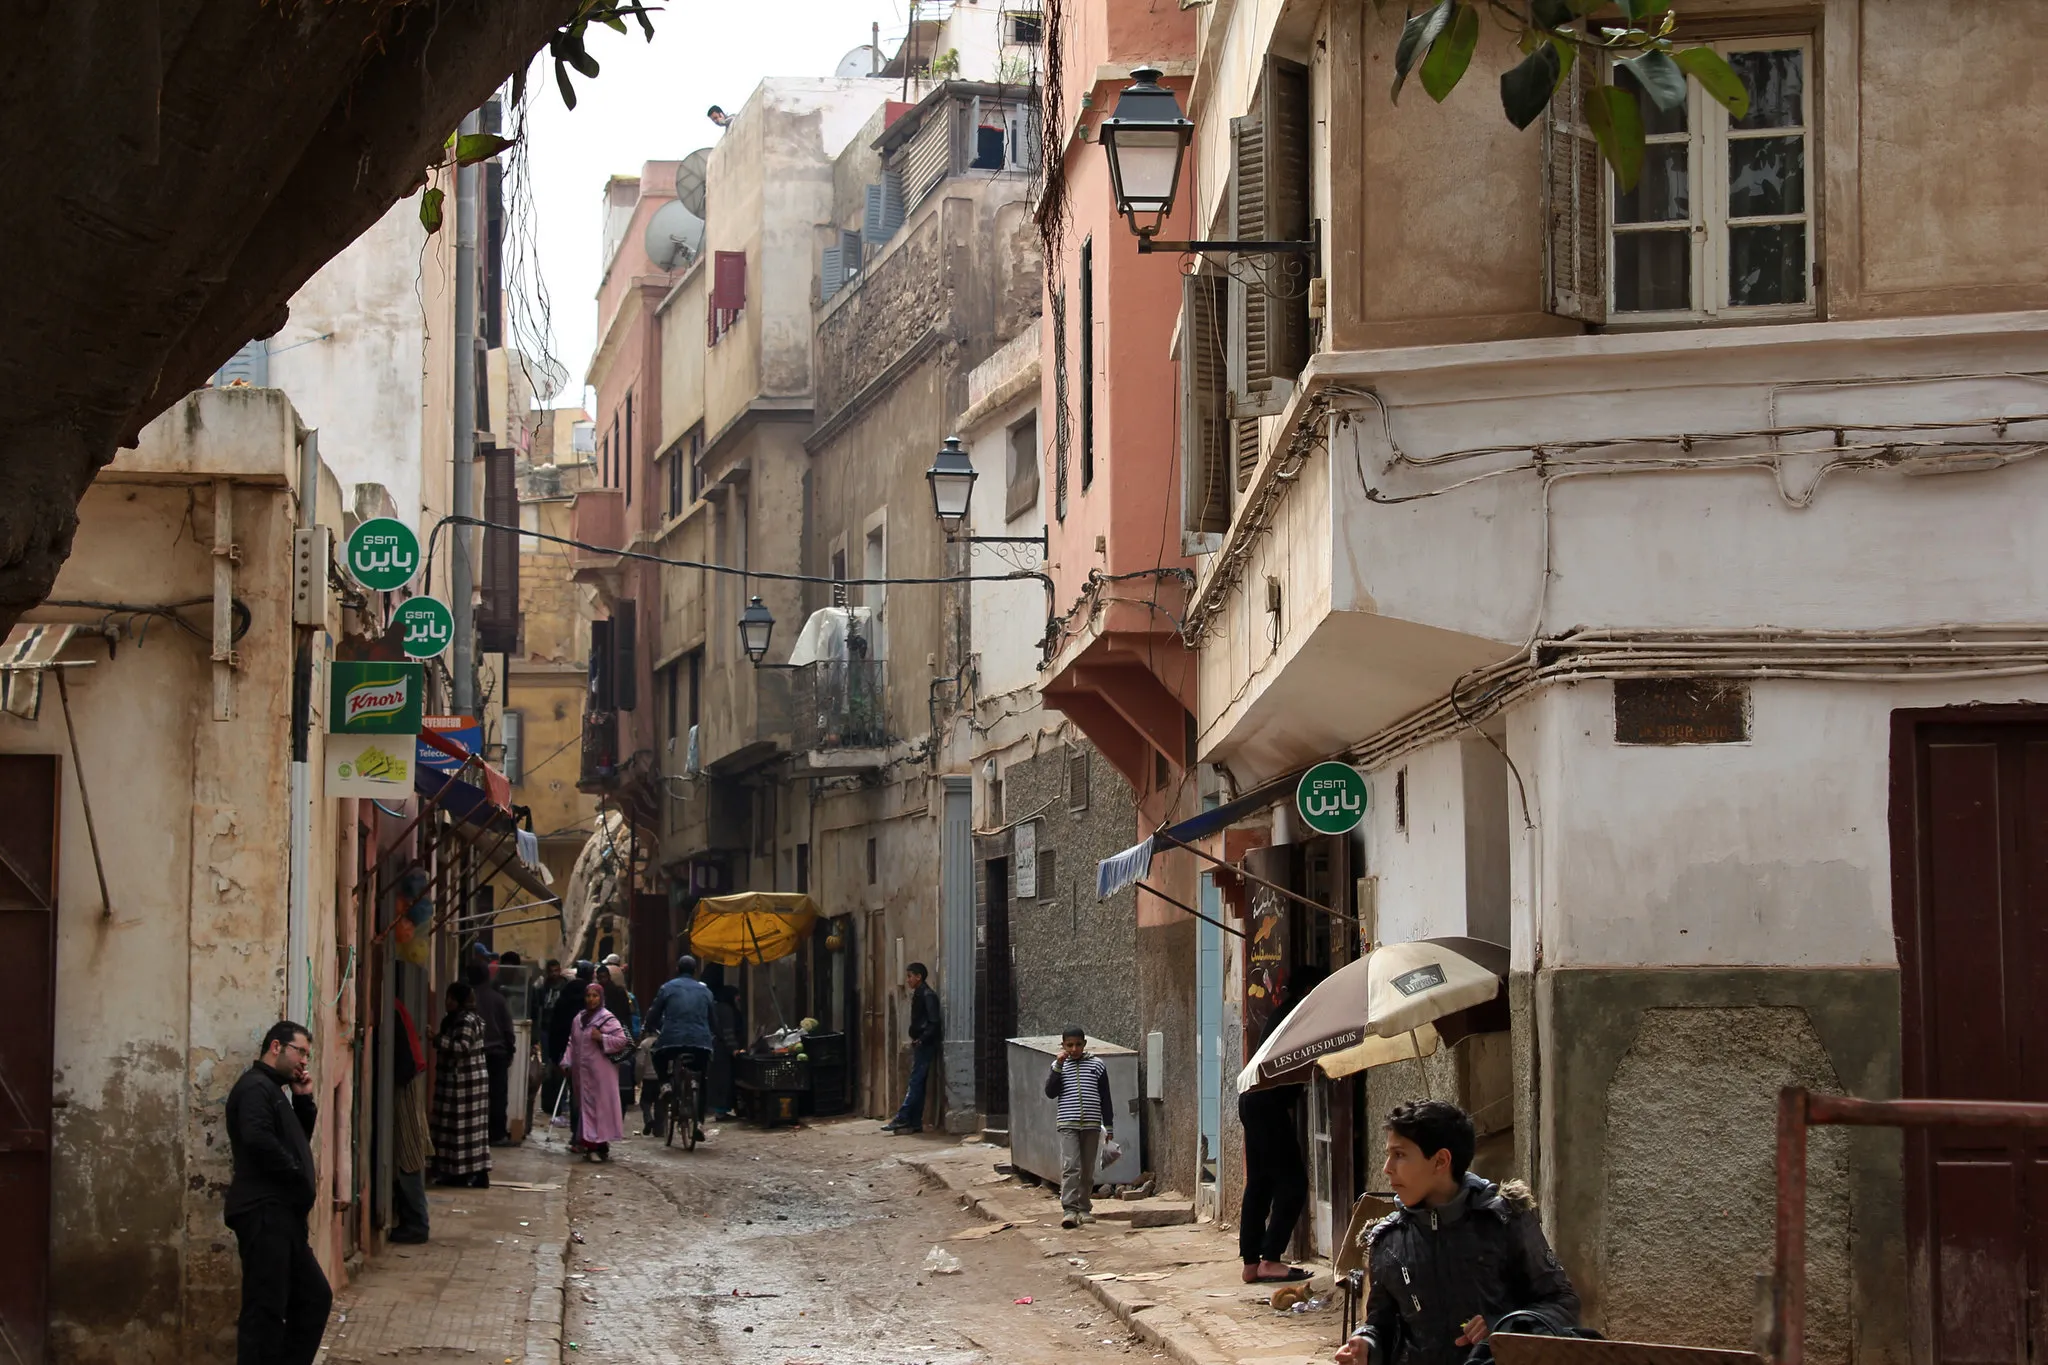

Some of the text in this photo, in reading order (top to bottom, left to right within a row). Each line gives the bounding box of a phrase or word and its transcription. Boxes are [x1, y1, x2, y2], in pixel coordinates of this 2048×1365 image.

[363, 535, 398, 545] GSM
[355, 545, 412, 573] باين
[405, 611, 435, 620] GSM
[348, 690, 404, 714] Knorr
[419, 749, 451, 758] Teleco
[1313, 779, 1346, 789] GSM
[1306, 789, 1360, 817] باين
[1273, 1031, 1357, 1069] LES CAFES DUBOIS
